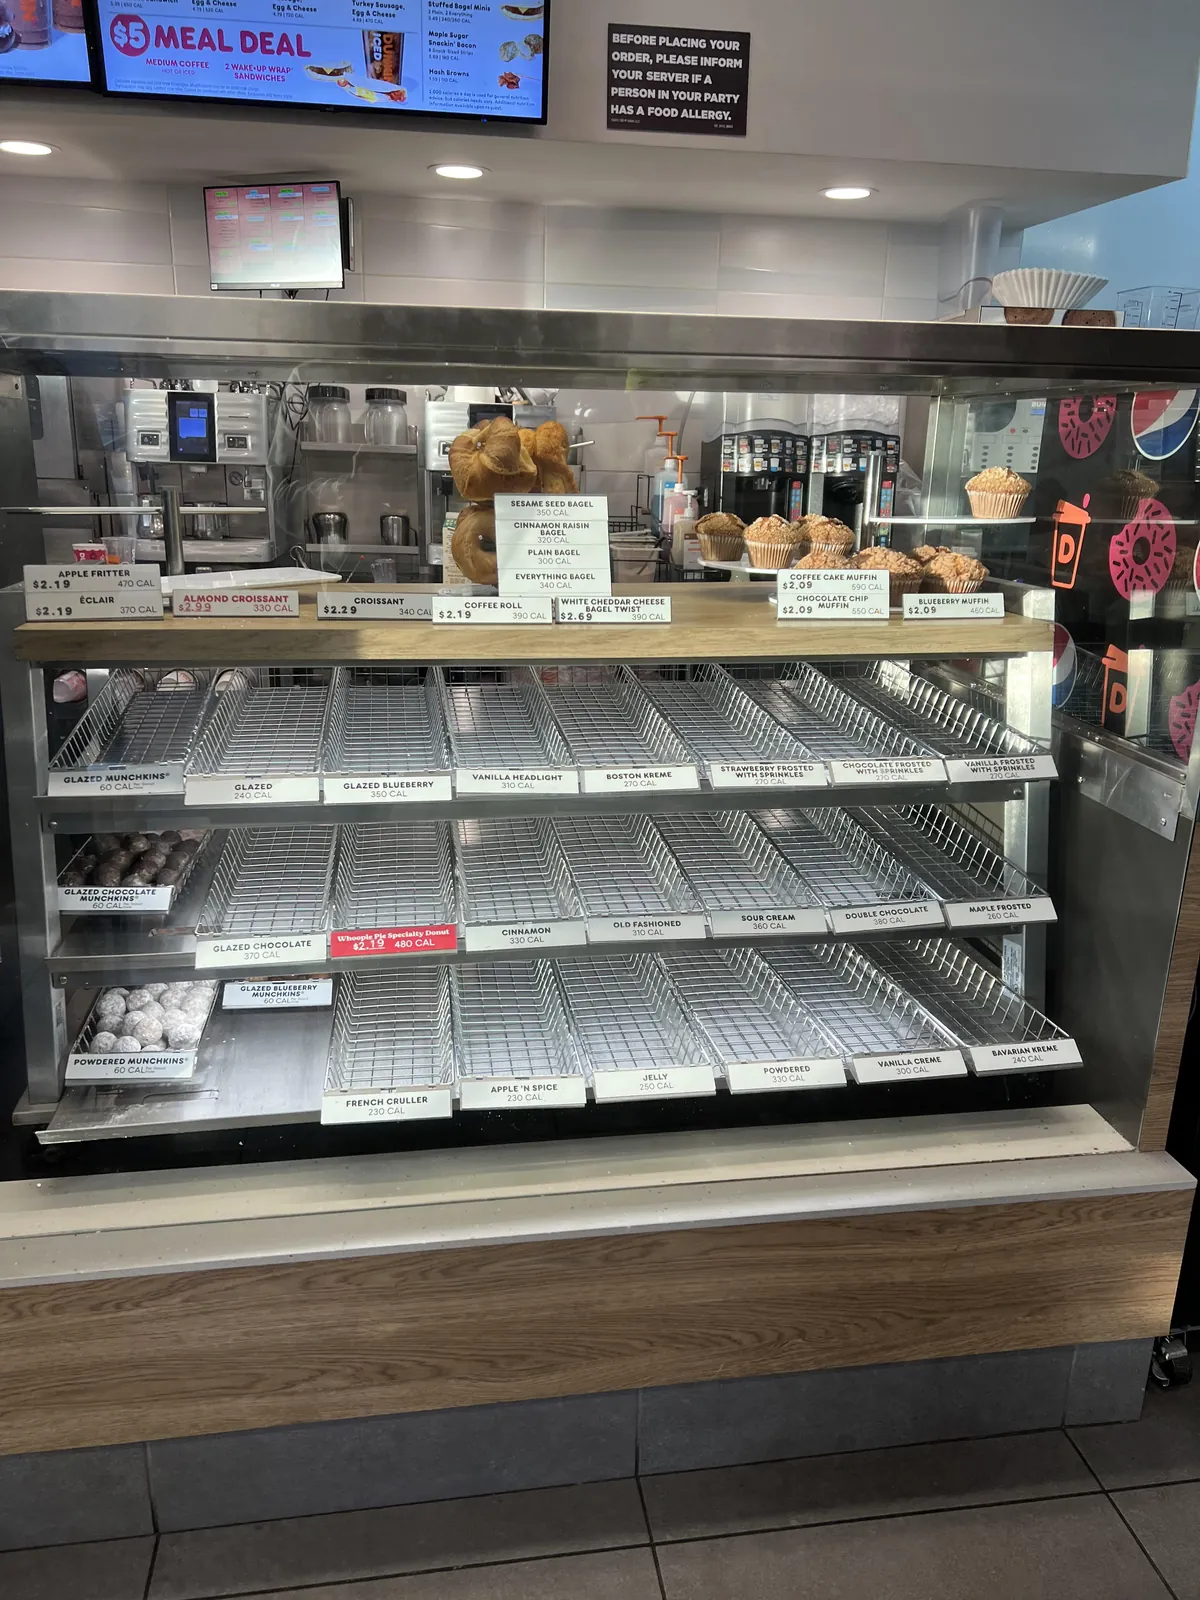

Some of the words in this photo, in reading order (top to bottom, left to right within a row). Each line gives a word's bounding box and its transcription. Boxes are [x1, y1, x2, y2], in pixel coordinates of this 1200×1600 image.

[352, 0, 374, 8] Turkey
[454, 3, 472, 11] Bagel
[113, 20, 146, 49] $5
[154, 24, 233, 53] MEAL
[240, 30, 311, 57] DEAL
[450, 32, 469, 40] Sugar
[457, 41, 477, 49] Bacon
[612, 33, 656, 45] BEFORE
[659, 36, 707, 49] PLACING
[710, 39, 740, 51] YOUR
[146, 58, 178, 67] MEDIUM
[179, 60, 209, 69] COFFEE
[612, 51, 653, 65] ORDER,
[656, 54, 698, 66] PLEASE
[700, 56, 743, 68] INFORM
[234, 72, 286, 82] SANDWICHES
[612, 69, 643, 81] YOUR
[646, 71, 689, 83] SERVER
[692, 74, 702, 83] IF
[704, 75, 712, 84] A
[611, 87, 656, 99] PERSON
[658, 90, 669, 99] IN
[672, 91, 701, 101] YOUR
[703, 92, 740, 104] PARTY
[611, 105, 634, 115] HAS
[636, 106, 644, 115] A
[648, 107, 678, 118] FOOD
[681, 109, 731, 121] ALLERGY.
[1058, 533, 1075, 564] D
[58, 570, 88, 578] APPLE
[91, 569, 130, 577] FRITTER
[33, 580, 70, 589] $2.19
[782, 581, 812, 590] $2.09
[184, 595, 229, 603] ALMOND
[231, 595, 289, 603] CROISSANT
[354, 597, 404, 605] CROISSANT
[36, 607, 72, 616] $2.19
[179, 603, 211, 612] $2.99
[324, 605, 357, 614] $2.29
[782, 606, 813, 614] $2.09
[908, 606, 937, 614] $2.09
[439, 610, 472, 619] $2.19
[560, 612, 592, 621] $2.69
[993, 764, 1036, 772] SPRINKLES
[64, 776, 102, 784] GLAZED
[382, 781, 434, 789] BLUEBERRY
[969, 904, 996, 913] MAPLE
[997, 903, 1031, 911] FROSTED
[845, 910, 878, 920] DOUBLE
[879, 906, 929, 917] CHOCOLATE
[633, 920, 681, 928] FASHIONED
[337, 933, 372, 942] Whoopie
[374, 932, 386, 940] Pie
[387, 930, 423, 939] Specialty
[502, 927, 551, 936] CINNAMON
[213, 943, 250, 952] GLAZED
[253, 940, 312, 950] CHOCOLATE
[353, 939, 385, 951] $2.19
[395, 940, 413, 948] 480
[415, 939, 435, 947] CAL
[992, 1047, 1030, 1056] BAVARIAN
[1031, 1045, 1058, 1053] KREME
[74, 1058, 126, 1066] POWDERED
[877, 1059, 913, 1068] VANILLA
[914, 1056, 942, 1065] CREME
[764, 1065, 810, 1074] POWDERED
[491, 1085, 519, 1093] APPLE
[346, 1098, 384, 1108] FRENCH
[386, 1096, 428, 1105] CRULLER
[368, 1108, 384, 1116] 230
[387, 1107, 405, 1115] CAL
